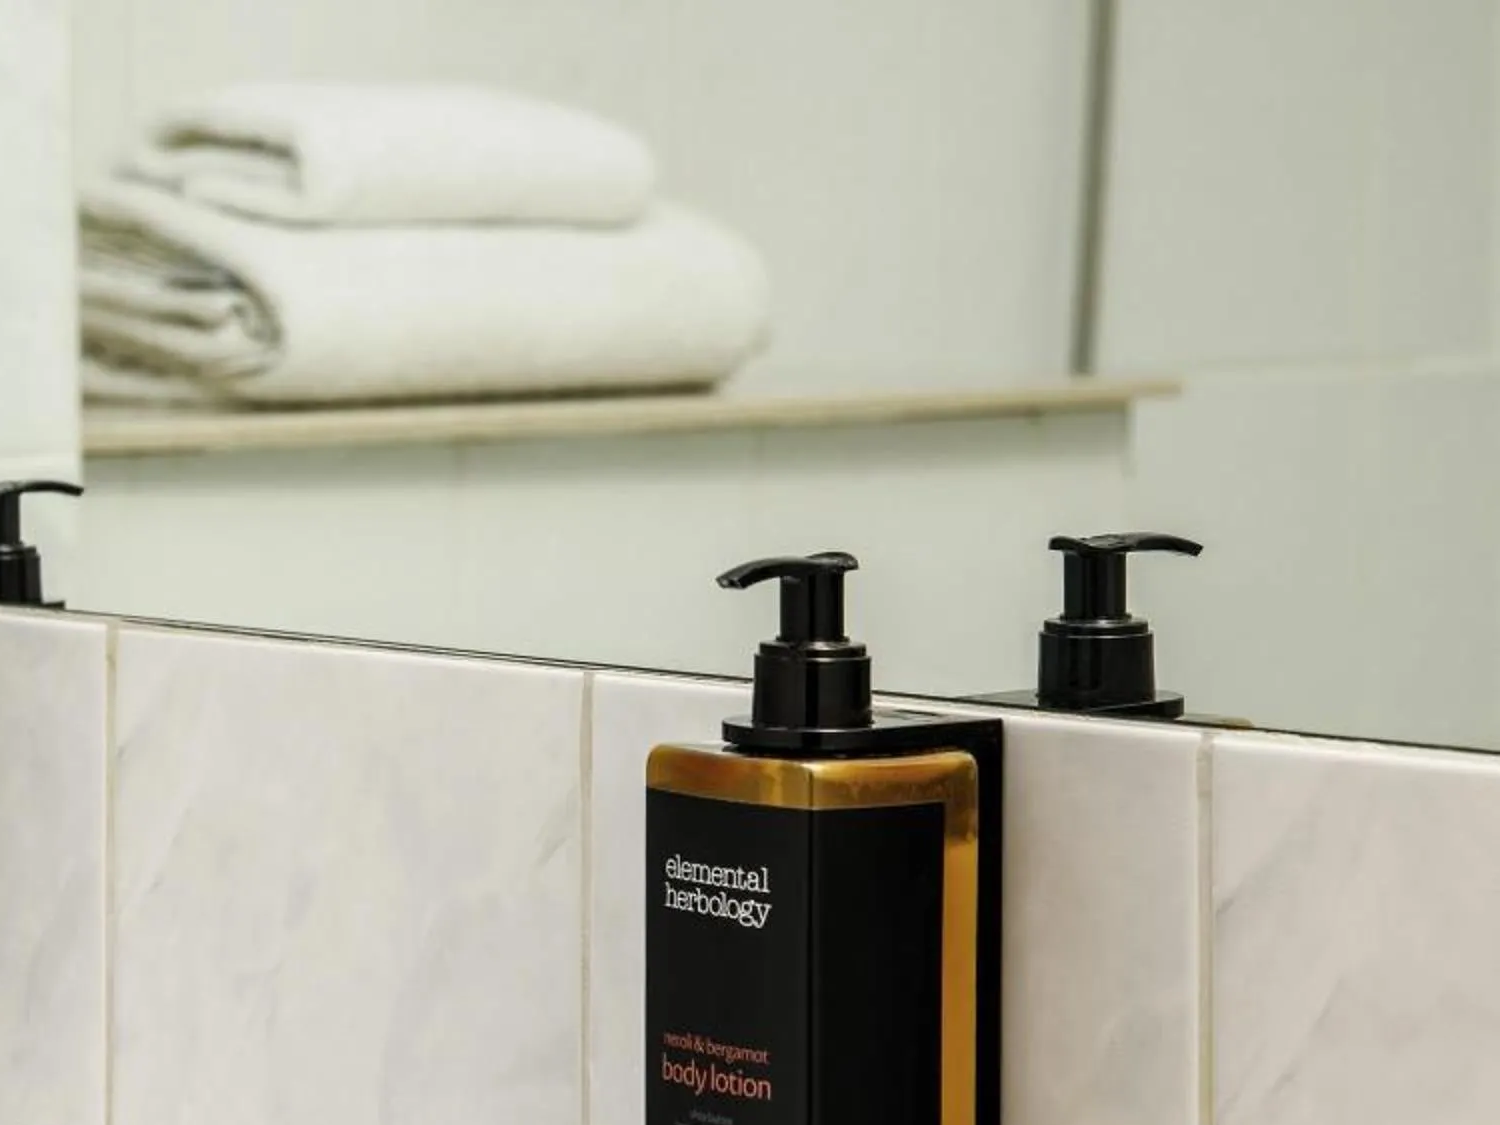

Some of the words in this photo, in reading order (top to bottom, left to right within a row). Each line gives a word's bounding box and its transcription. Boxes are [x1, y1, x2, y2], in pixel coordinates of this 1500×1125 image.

[665, 853, 771, 893] elemental
[664, 881, 772, 929] herbology
[663, 1032, 694, 1049] neroli
[693, 1035, 705, 1054] &
[706, 1038, 770, 1065] bergamot
[662, 1052, 707, 1097] body
[710, 1063, 772, 1101] lotion
